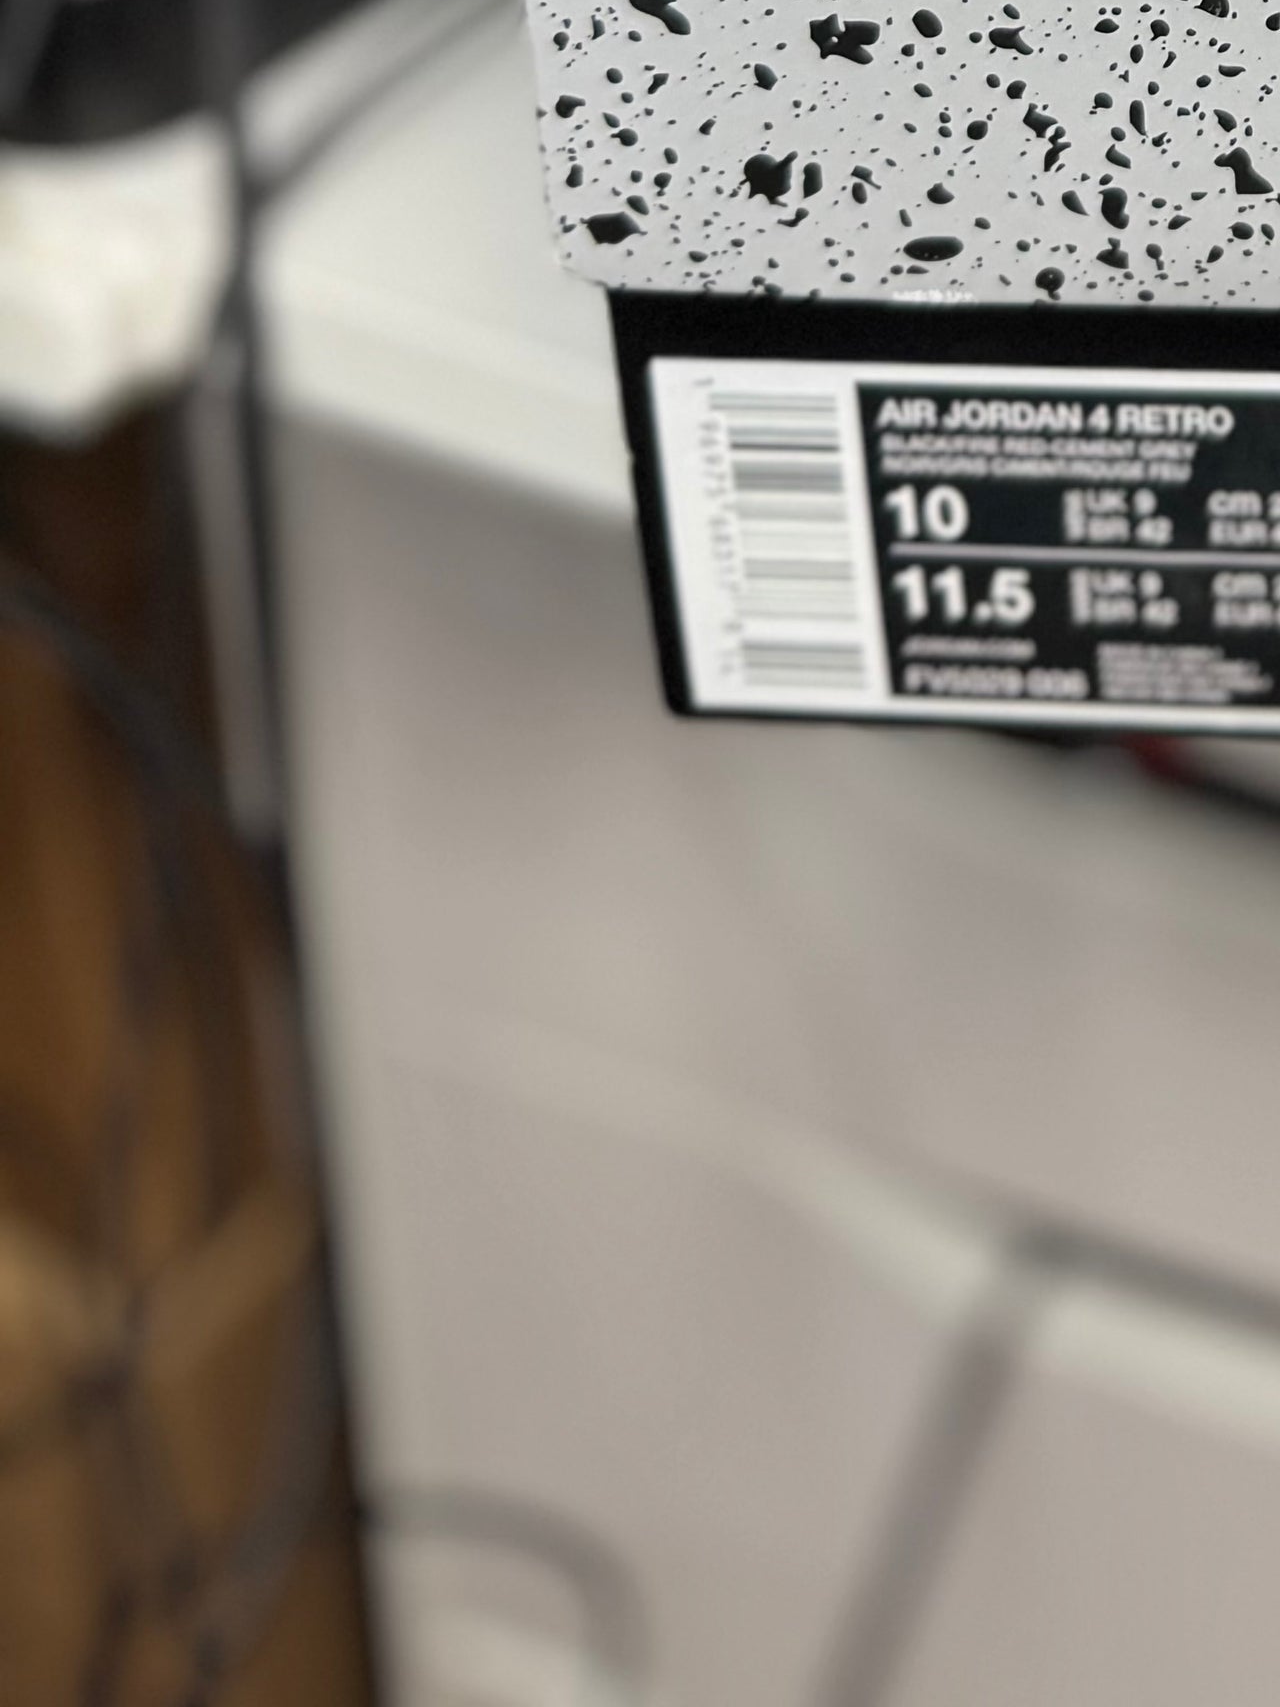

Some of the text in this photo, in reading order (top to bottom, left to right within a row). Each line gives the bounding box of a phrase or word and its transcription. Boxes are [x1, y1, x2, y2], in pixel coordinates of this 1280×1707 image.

[877, 398, 1235, 438] AIR JORDAN 4 RETRO
[884, 484, 969, 541] 10
[1086, 488, 1128, 513] UK
[1135, 515, 1174, 545] 42
[1208, 519, 1268, 546] EUR
[892, 565, 1035, 626] 11.5
[1091, 569, 1133, 595] UK
[1213, 600, 1273, 627] EUR
